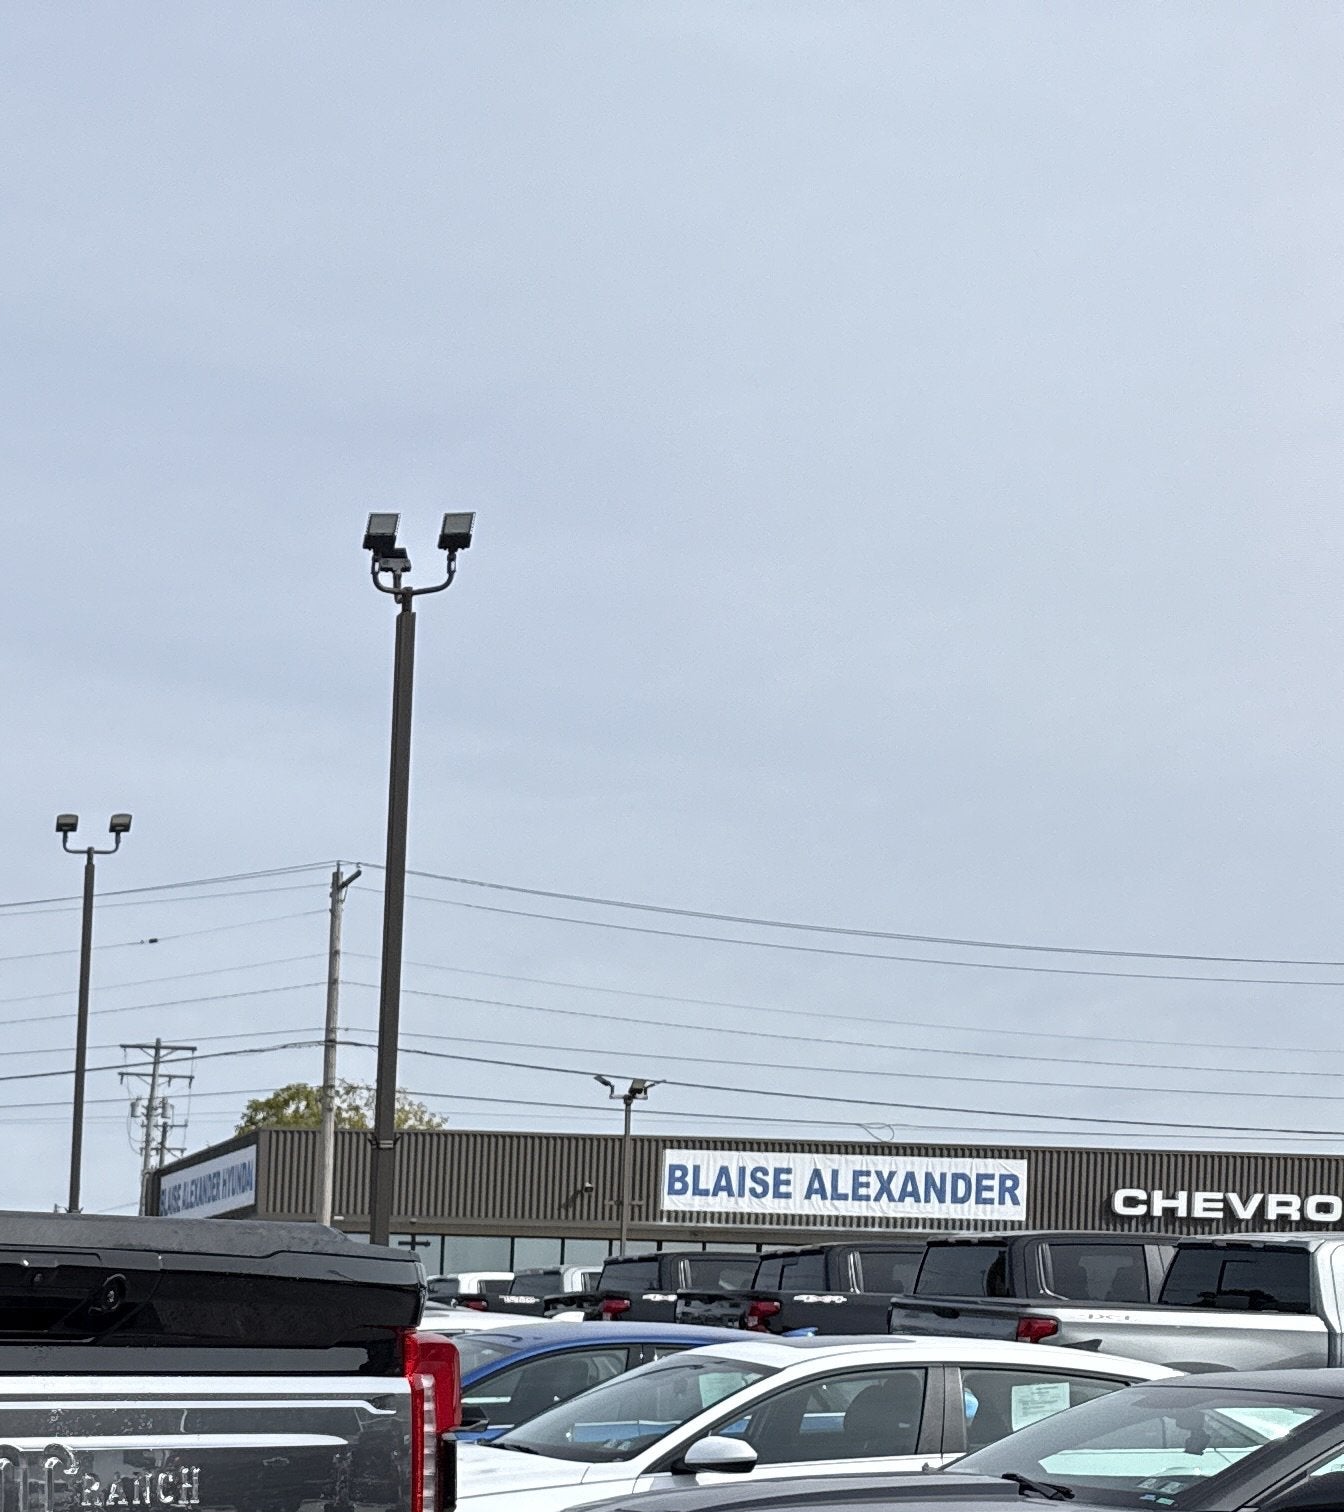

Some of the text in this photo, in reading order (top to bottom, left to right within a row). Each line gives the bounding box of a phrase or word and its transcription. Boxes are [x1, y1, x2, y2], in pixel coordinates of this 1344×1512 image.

[667, 1163, 1021, 1206] BLAISE ALEXANDER
[1112, 1188, 1343, 1222] CHEVRO
[79, 1466, 201, 1507] RANCH
